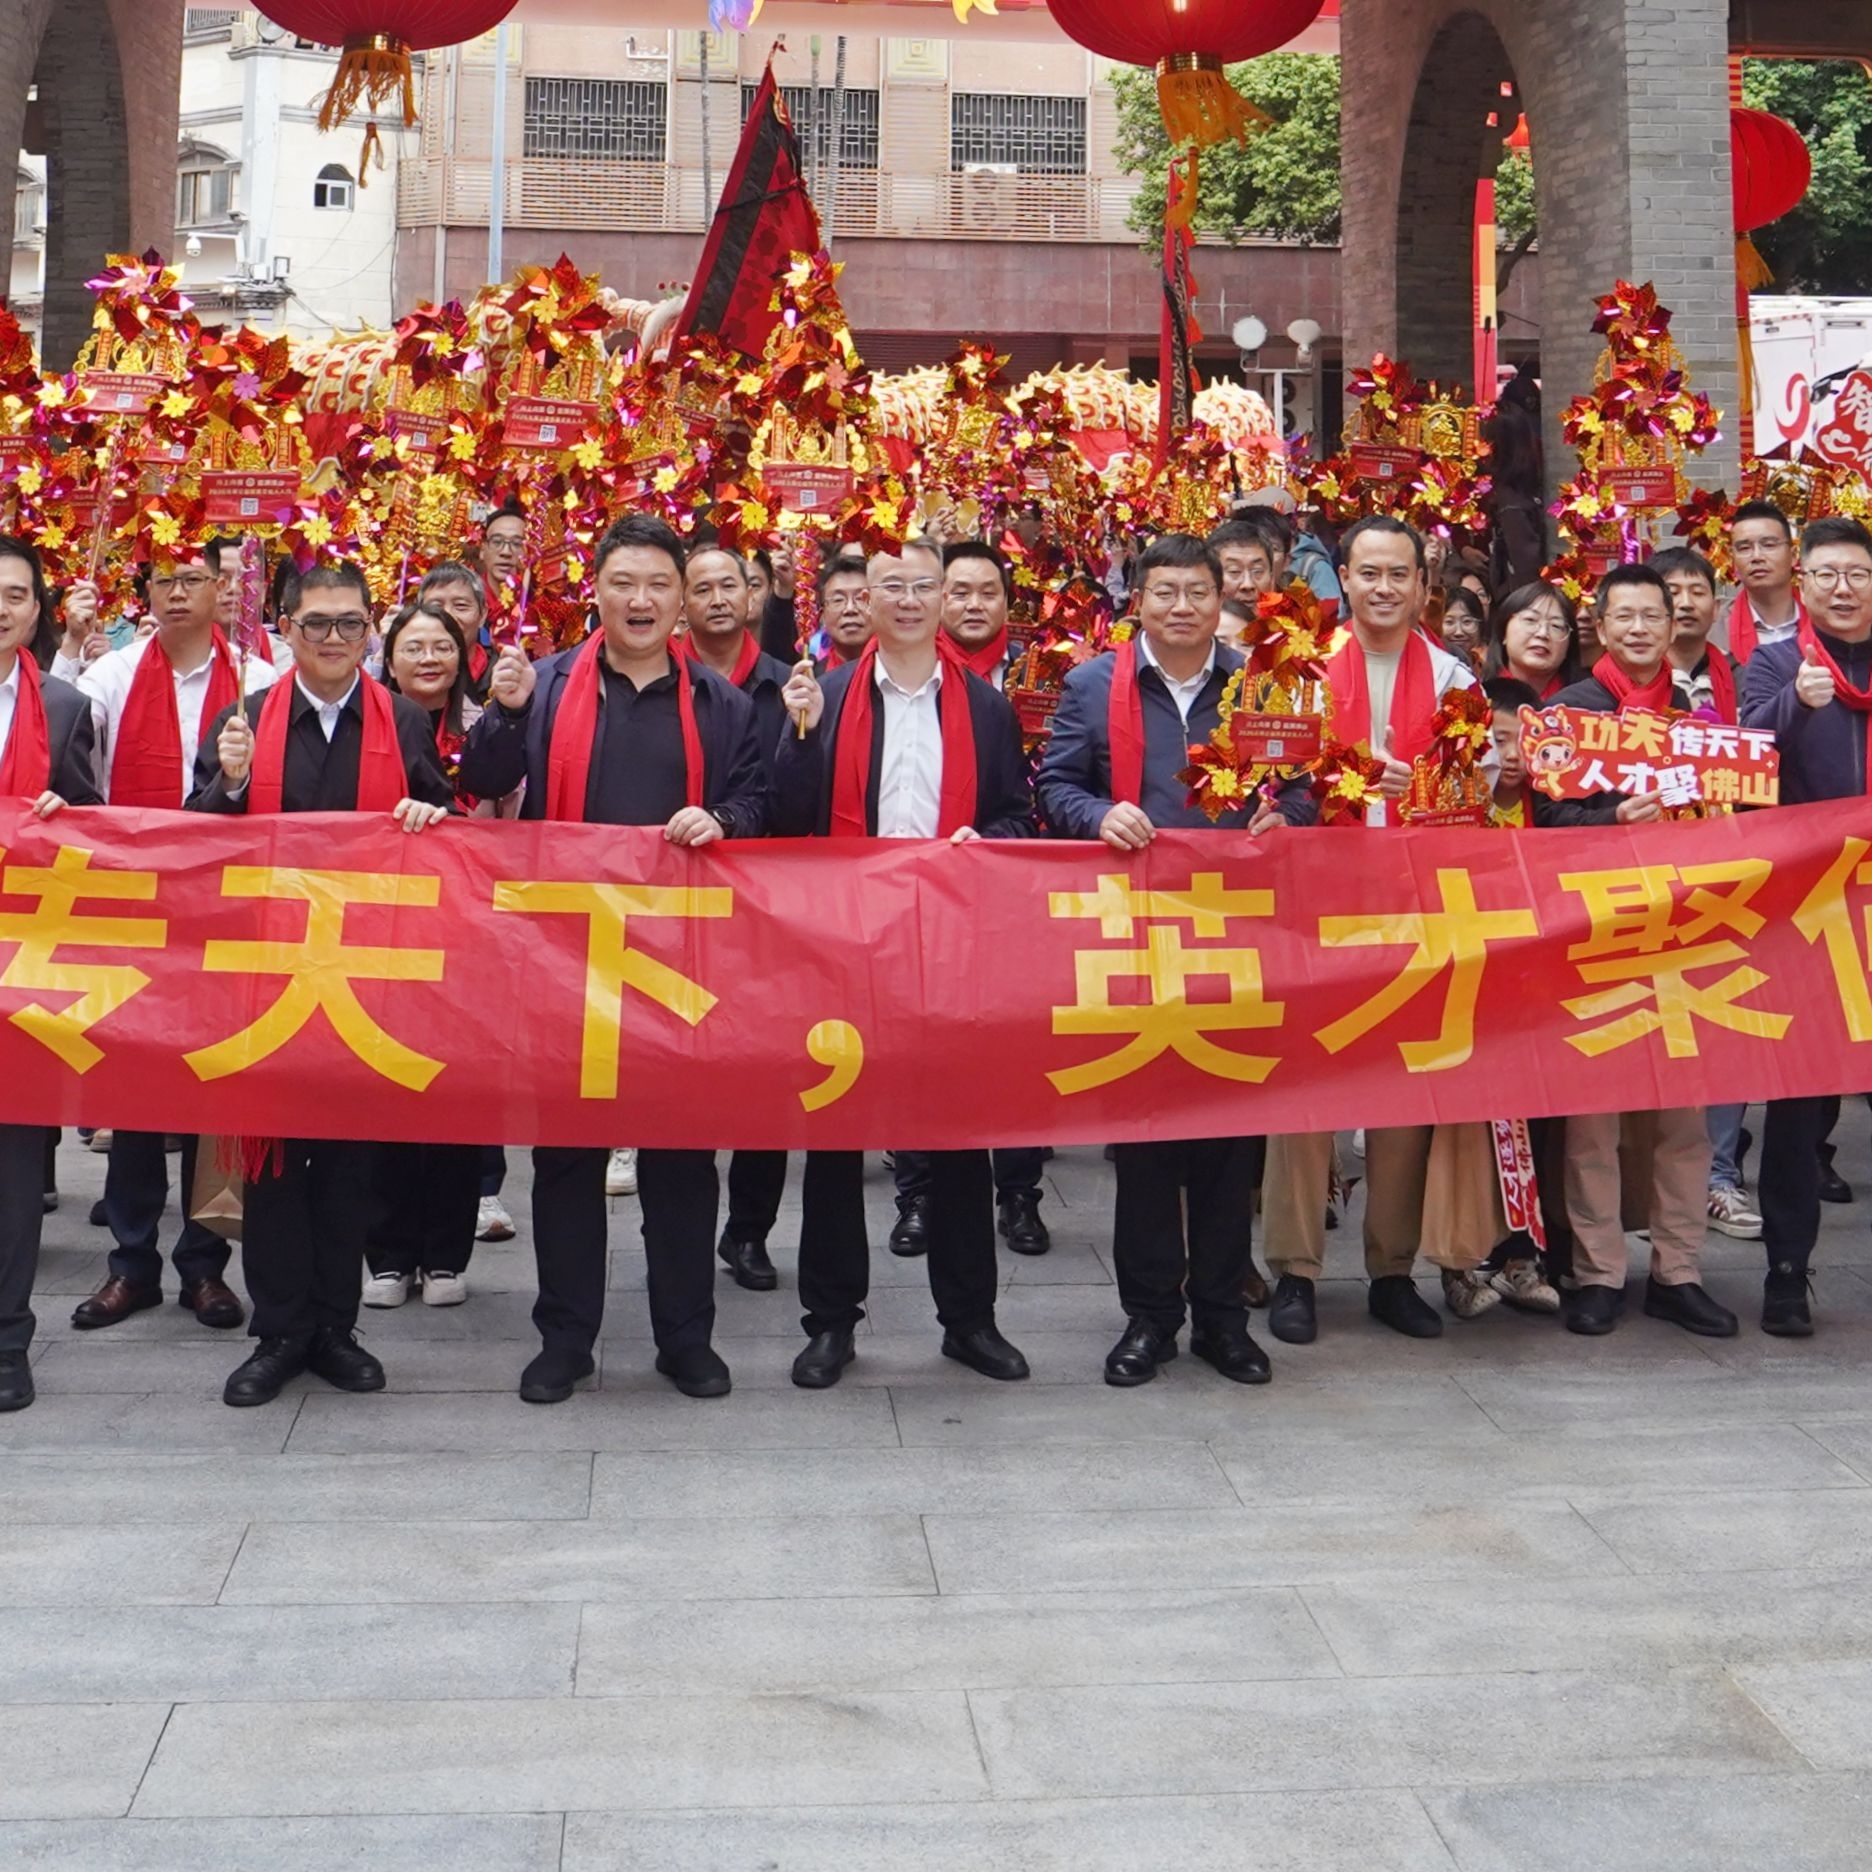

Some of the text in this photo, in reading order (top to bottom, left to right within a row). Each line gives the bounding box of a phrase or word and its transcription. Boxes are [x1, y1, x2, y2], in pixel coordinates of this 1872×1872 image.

[1579, 710, 1776, 761] 功夫传天下
[1578, 759, 1779, 808] 人才聚佛山
